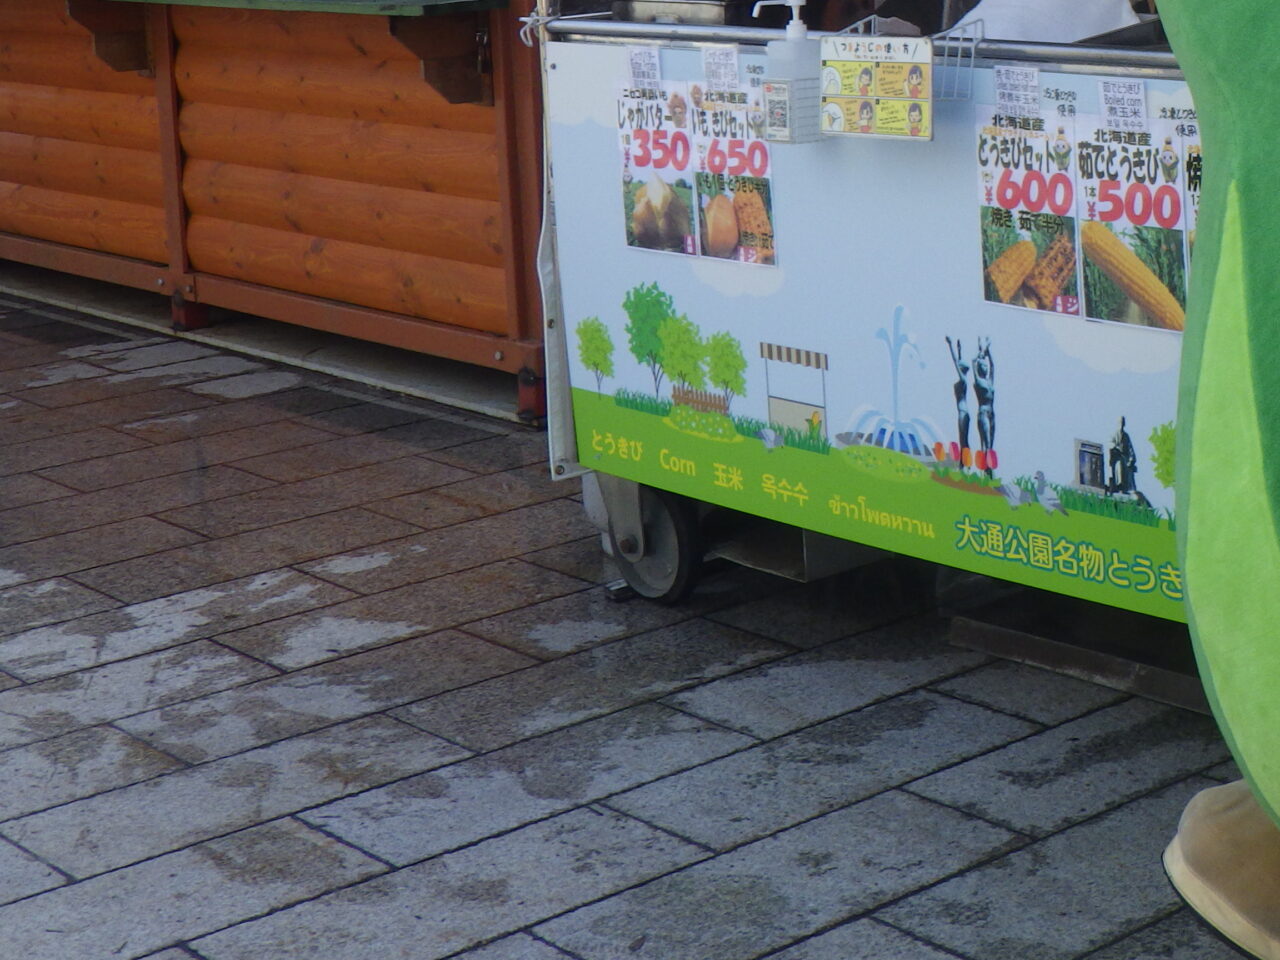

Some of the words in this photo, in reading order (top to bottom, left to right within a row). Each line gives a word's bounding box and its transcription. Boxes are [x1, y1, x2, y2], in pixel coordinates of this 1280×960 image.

[617, 100, 673, 130] じゃがバター
[704, 90, 748, 105] 北海道産
[1104, 95, 1125, 107] Boiled
[992, 114, 1046, 132] 北海道産
[1094, 129, 1152, 146] 北海道産
[632, 128, 691, 172] 350
[707, 138, 769, 178] 650
[977, 134, 1055, 174] とうきびセット
[1077, 141, 1160, 185] 茹でとうきび
[996, 168, 1074, 216] 600
[1098, 180, 1182, 229] 500
[592, 429, 644, 461] とうきび
[659, 448, 697, 477] Corn
[713, 462, 744, 491] 玉米
[761, 473, 808, 507] 옥수수
[954, 514, 1185, 601] 大通公園名物とうき
